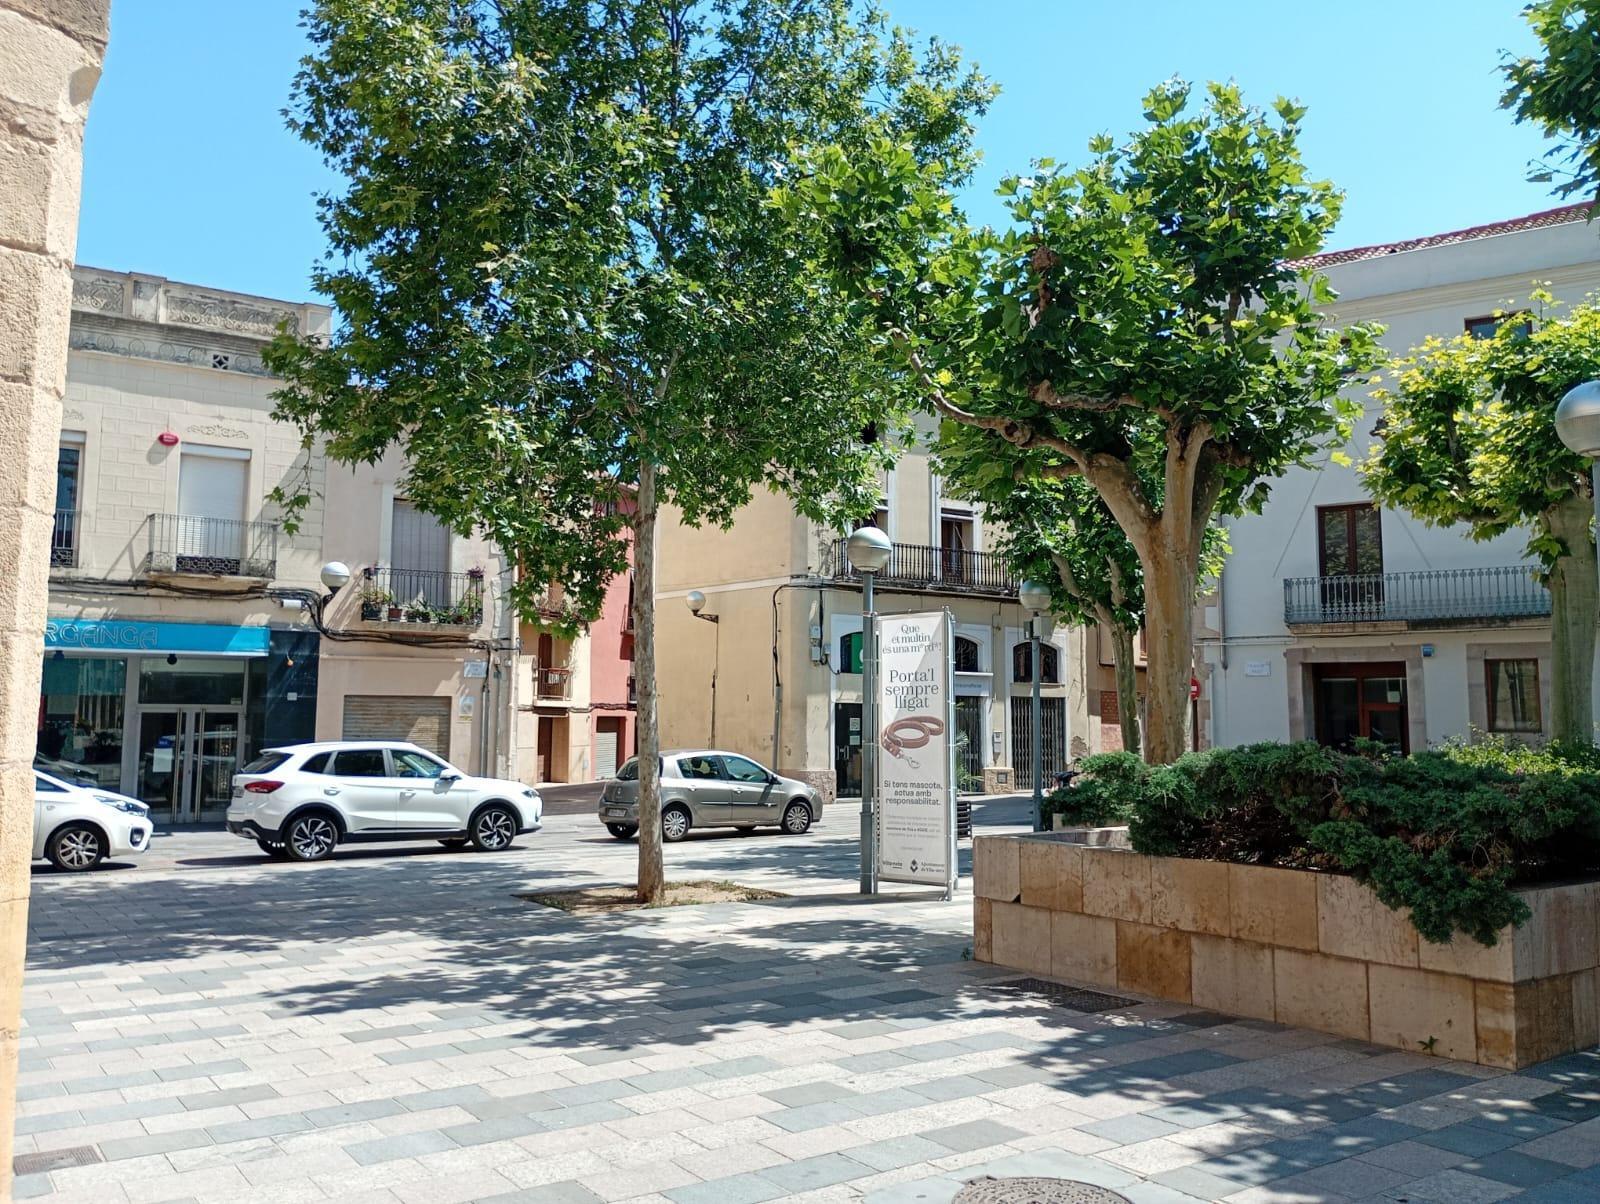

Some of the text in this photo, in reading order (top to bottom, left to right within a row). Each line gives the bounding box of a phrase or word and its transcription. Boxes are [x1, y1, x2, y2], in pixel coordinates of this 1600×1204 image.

[901, 624, 920, 633] Que
[891, 633, 931, 644] et multin
[892, 646, 909, 654] una
[889, 668, 935, 683] Porta'l
[885, 684, 939, 698] sempre
[895, 695, 929, 711] lligat
[883, 780, 891, 788] Si
[909, 781, 943, 790] mascota,
[894, 789, 914, 797] actua
[885, 797, 941, 806] responsabilitat.
